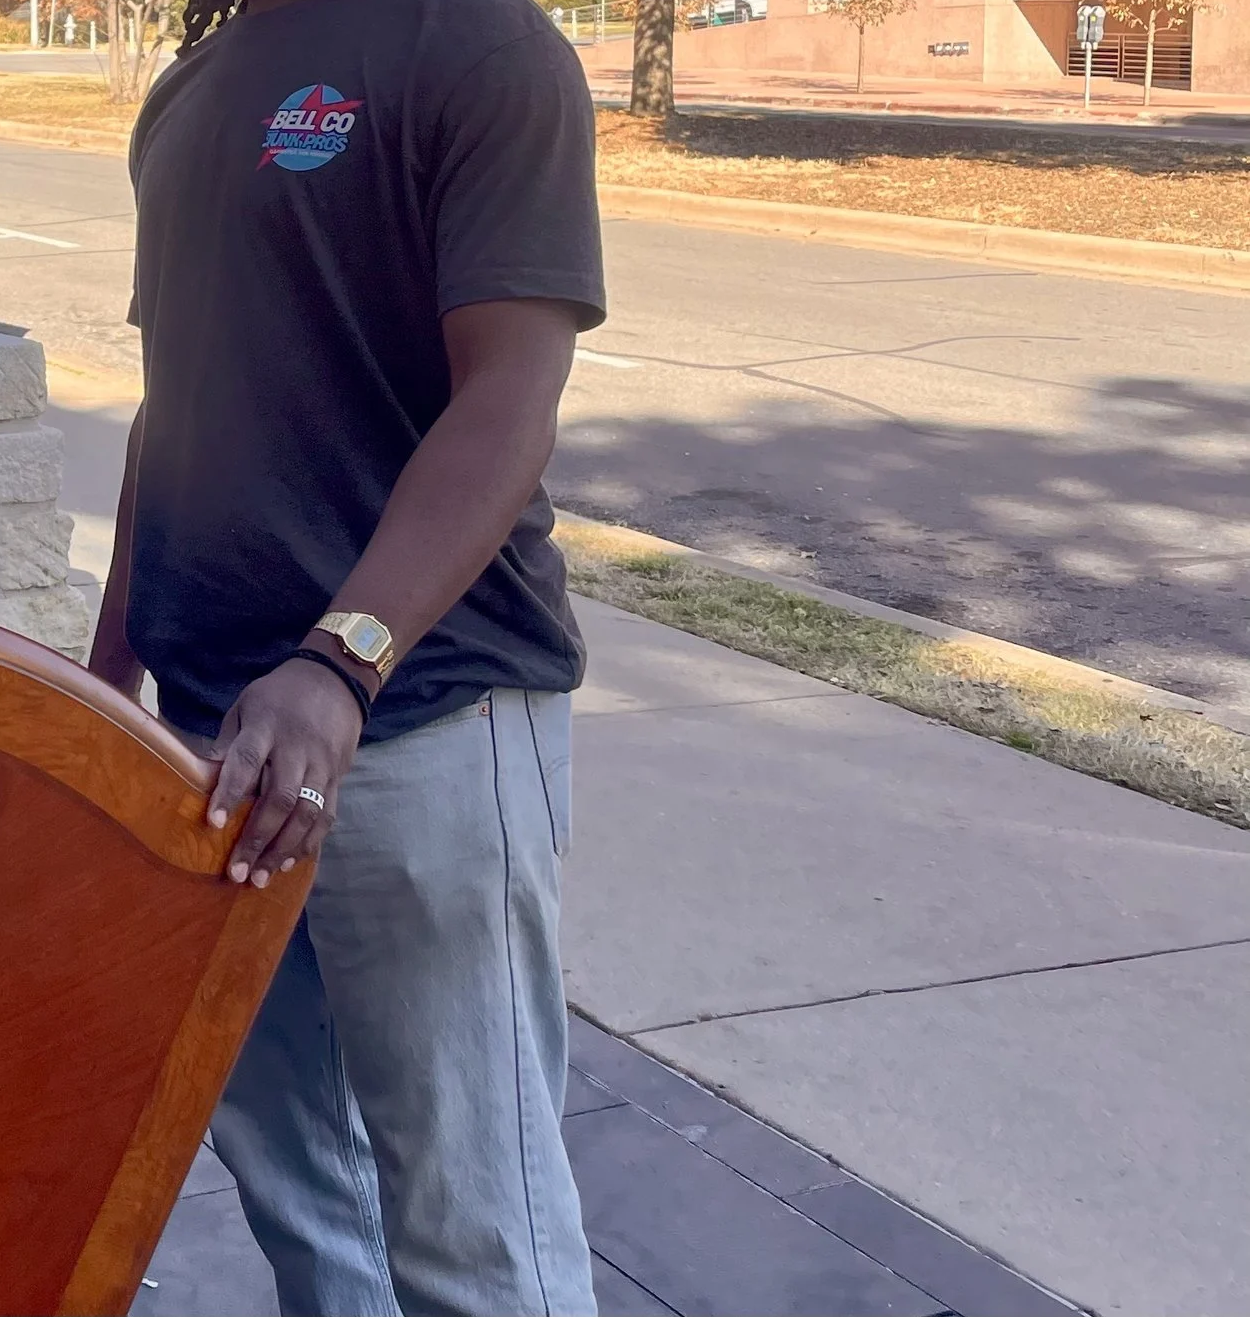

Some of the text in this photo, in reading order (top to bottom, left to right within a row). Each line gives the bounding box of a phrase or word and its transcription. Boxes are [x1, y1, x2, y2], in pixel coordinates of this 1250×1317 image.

[269, 109, 356, 134] BELL CO
[262, 132, 303, 148] JUNK
[302, 135, 349, 153] PROS
